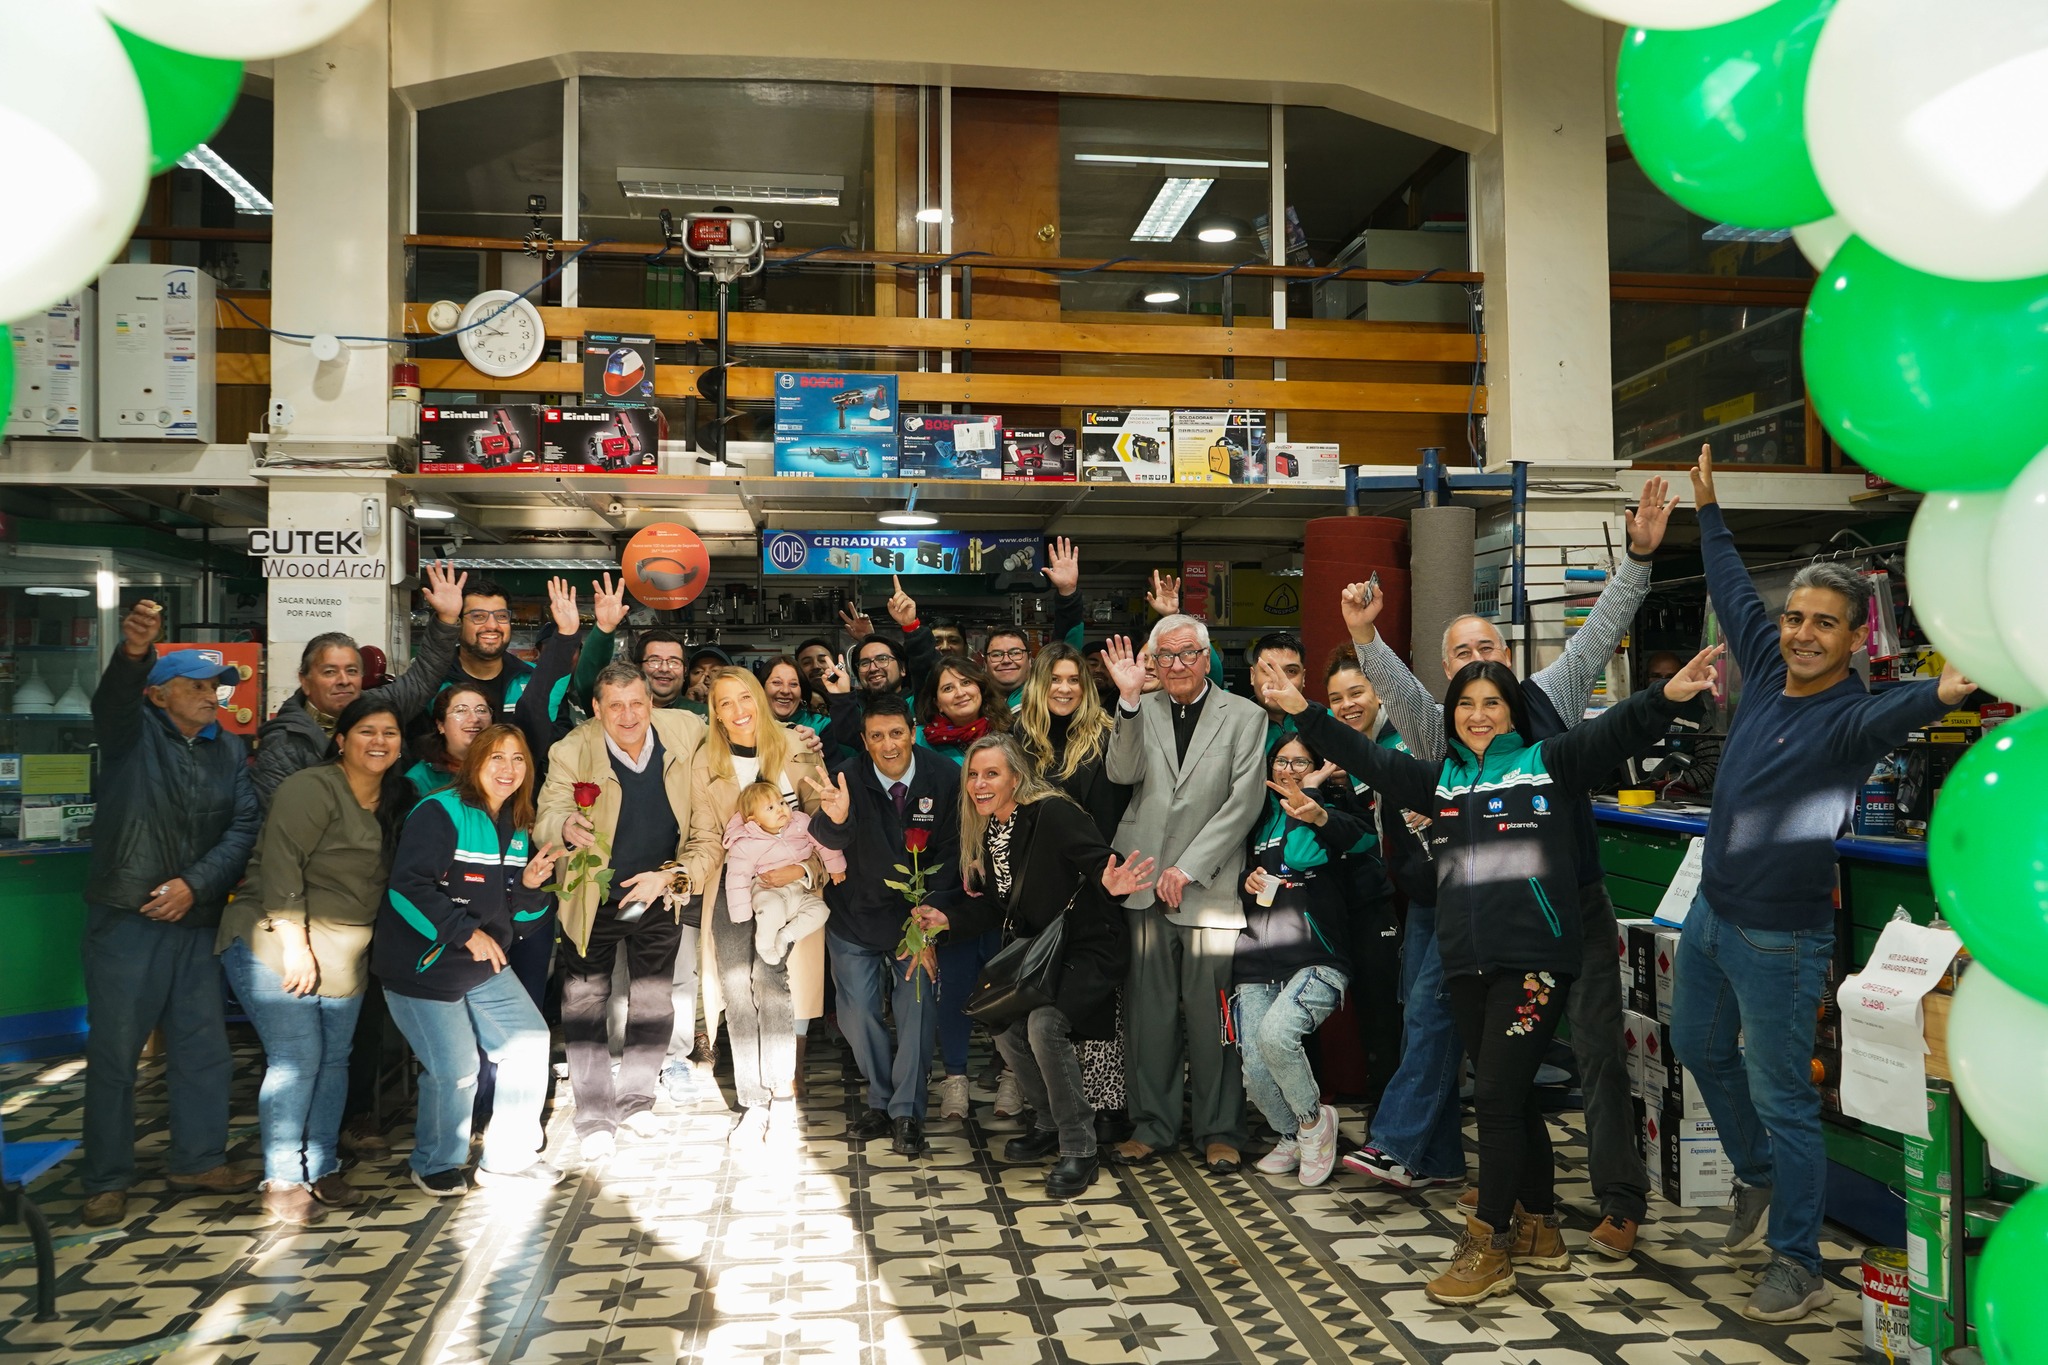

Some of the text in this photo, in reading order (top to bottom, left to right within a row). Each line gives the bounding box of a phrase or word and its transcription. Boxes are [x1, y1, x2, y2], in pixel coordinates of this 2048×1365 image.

[167, 281, 188, 296] 14
[519, 320, 526, 328] 2
[474, 329, 482, 337] 9
[522, 331, 530, 340] 3
[519, 342, 526, 350] 4
[487, 350, 493, 358] 7
[801, 376, 844, 388] BOSCH
[440, 410, 488, 419] Einhell
[563, 412, 610, 421] Einhell
[248, 530, 359, 555] CUTEK
[813, 536, 907, 547] CERRADURAS
[305, 597, 342, 606] NÚMERO
[287, 609, 332, 618] POR FAVOR
[1489, 800, 1503, 810] VH
[1507, 821, 1538, 830] pizarreño
[1888, 953, 1897, 961] KIT
[1919, 957, 1929, 965] DE
[1861, 982, 1895, 994] OFERTA
[1867, 1052, 1885, 1062] OFERTA
